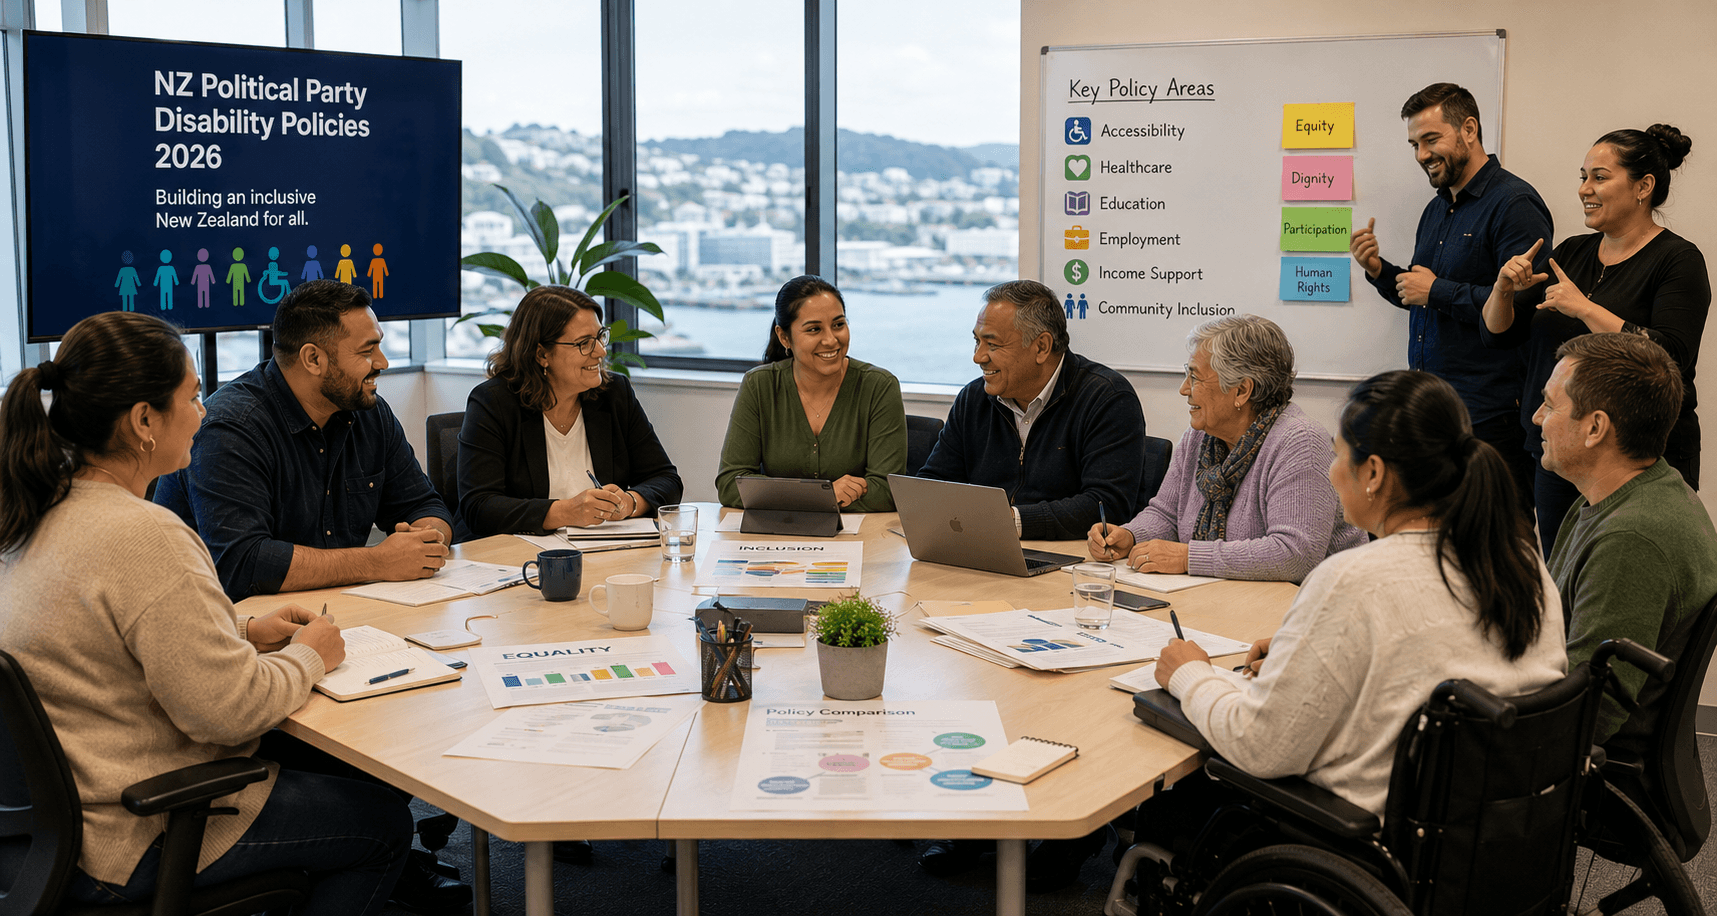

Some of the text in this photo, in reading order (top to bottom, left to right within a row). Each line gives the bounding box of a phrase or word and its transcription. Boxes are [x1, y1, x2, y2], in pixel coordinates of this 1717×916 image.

[154, 70, 368, 110] NZ Political Party
[1068, 77, 1215, 105] Key Policy Areas
[154, 106, 371, 141] Disability Policies
[1100, 123, 1186, 141] Accessibility
[1295, 119, 1335, 135] Equity
[154, 143, 223, 169] 2026
[1100, 160, 1173, 174] Healthcare
[1291, 171, 1335, 189] Dignity
[155, 188, 317, 209] Building an inclusive
[1100, 196, 1166, 211] Education
[155, 210, 309, 229] New Zealand for all.
[1283, 222, 1348, 238] Participation
[1099, 231, 1181, 249] Employment
[1099, 266, 1204, 283] Income Support
[1295, 266, 1333, 278] Human
[1297, 281, 1331, 295] Rights
[1098, 301, 1236, 319] Community Inclusion
[503, 645, 612, 660] EQUALITY
[766, 708, 916, 717] Policy Comparison
